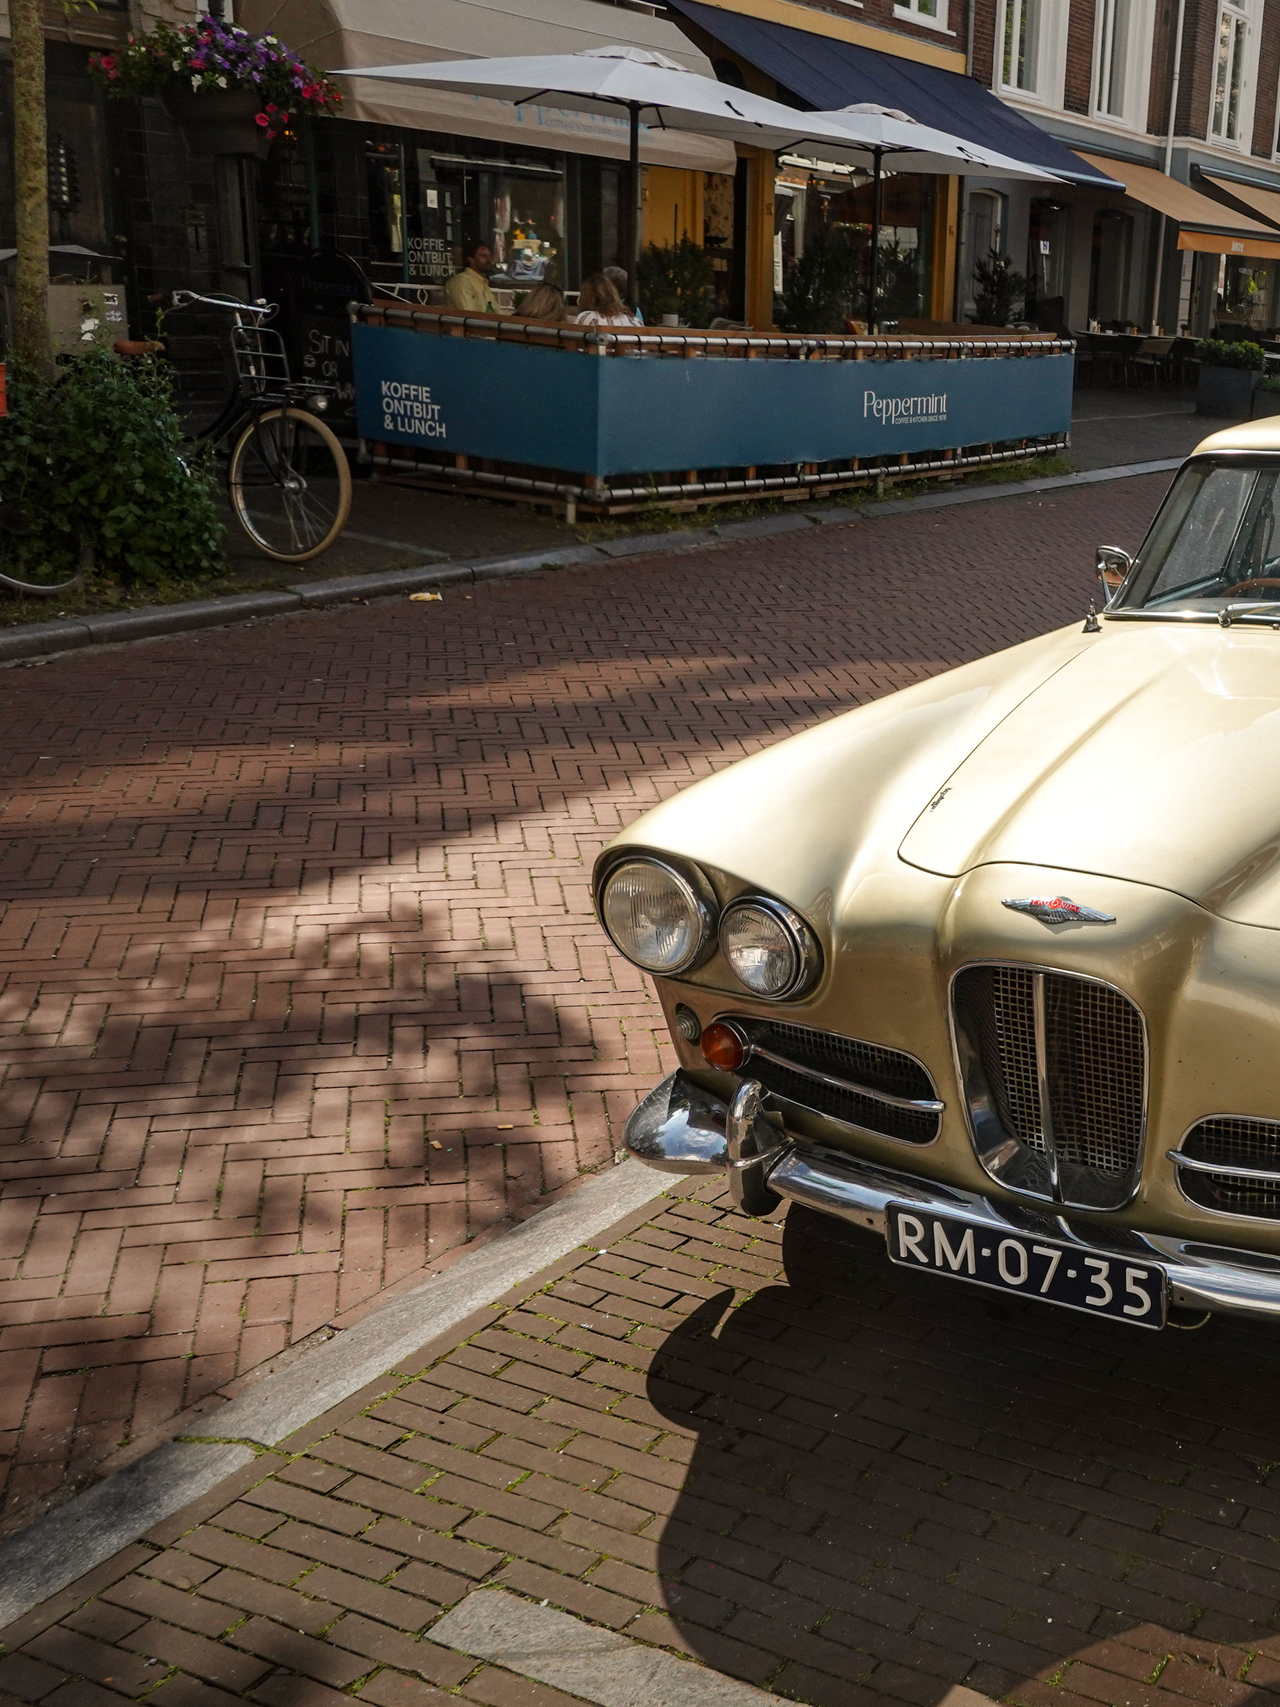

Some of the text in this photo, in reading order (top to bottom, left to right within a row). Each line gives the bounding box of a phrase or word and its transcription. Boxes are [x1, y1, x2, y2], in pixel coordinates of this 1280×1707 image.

[407, 238, 445, 251] KOFFIE
[408, 250, 452, 263] ONTBIJT
[409, 264, 456, 277] & LUNCH
[309, 329, 331, 354] SIT
[321, 360, 338, 377] OR
[381, 380, 431, 403] KOFFIE
[382, 397, 441, 421] ONTBIJT
[863, 390, 947, 425] Peppermint
[384, 414, 446, 438] & LUNCH
[1030, 898, 1082, 912] LAGONDA
